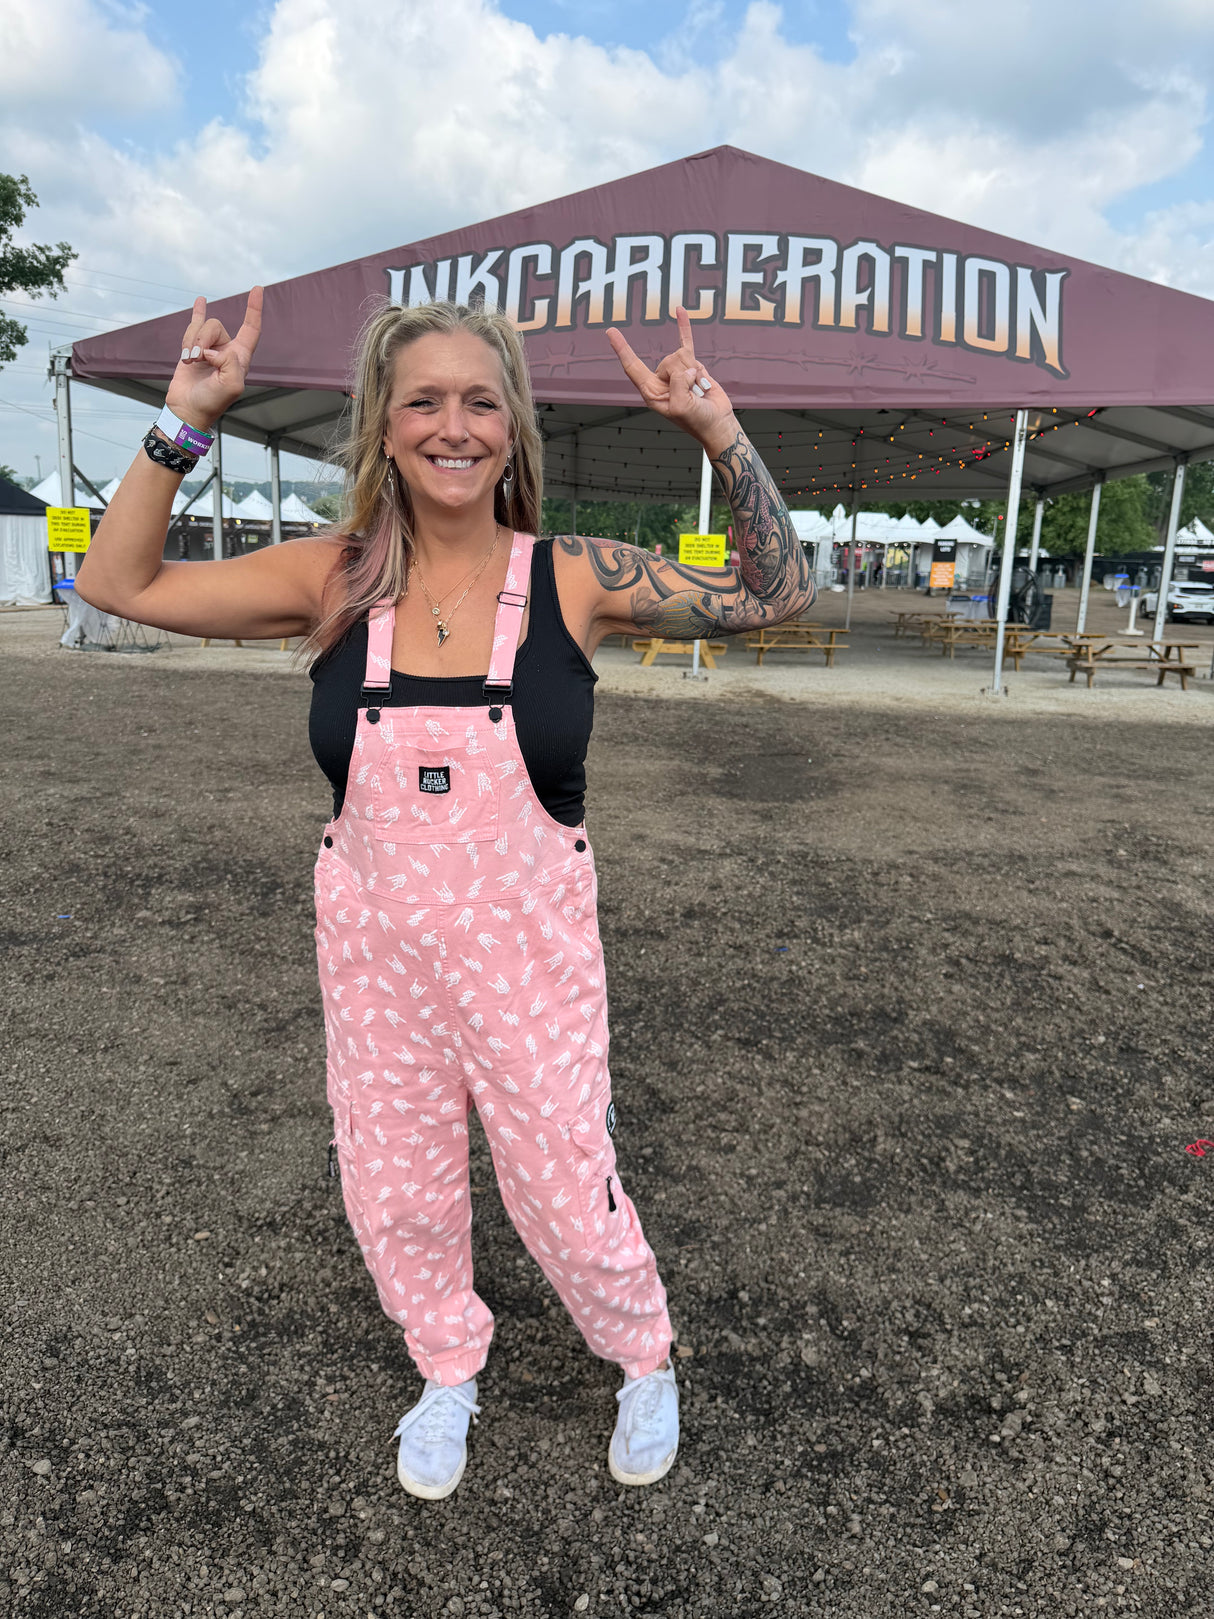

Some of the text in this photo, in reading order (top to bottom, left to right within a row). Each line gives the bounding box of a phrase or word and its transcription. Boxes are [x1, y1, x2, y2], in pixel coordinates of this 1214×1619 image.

[423, 771, 445, 779] LITTLE
[422, 777, 447, 785] ROCKER
[420, 783, 449, 792] CLOTHING
